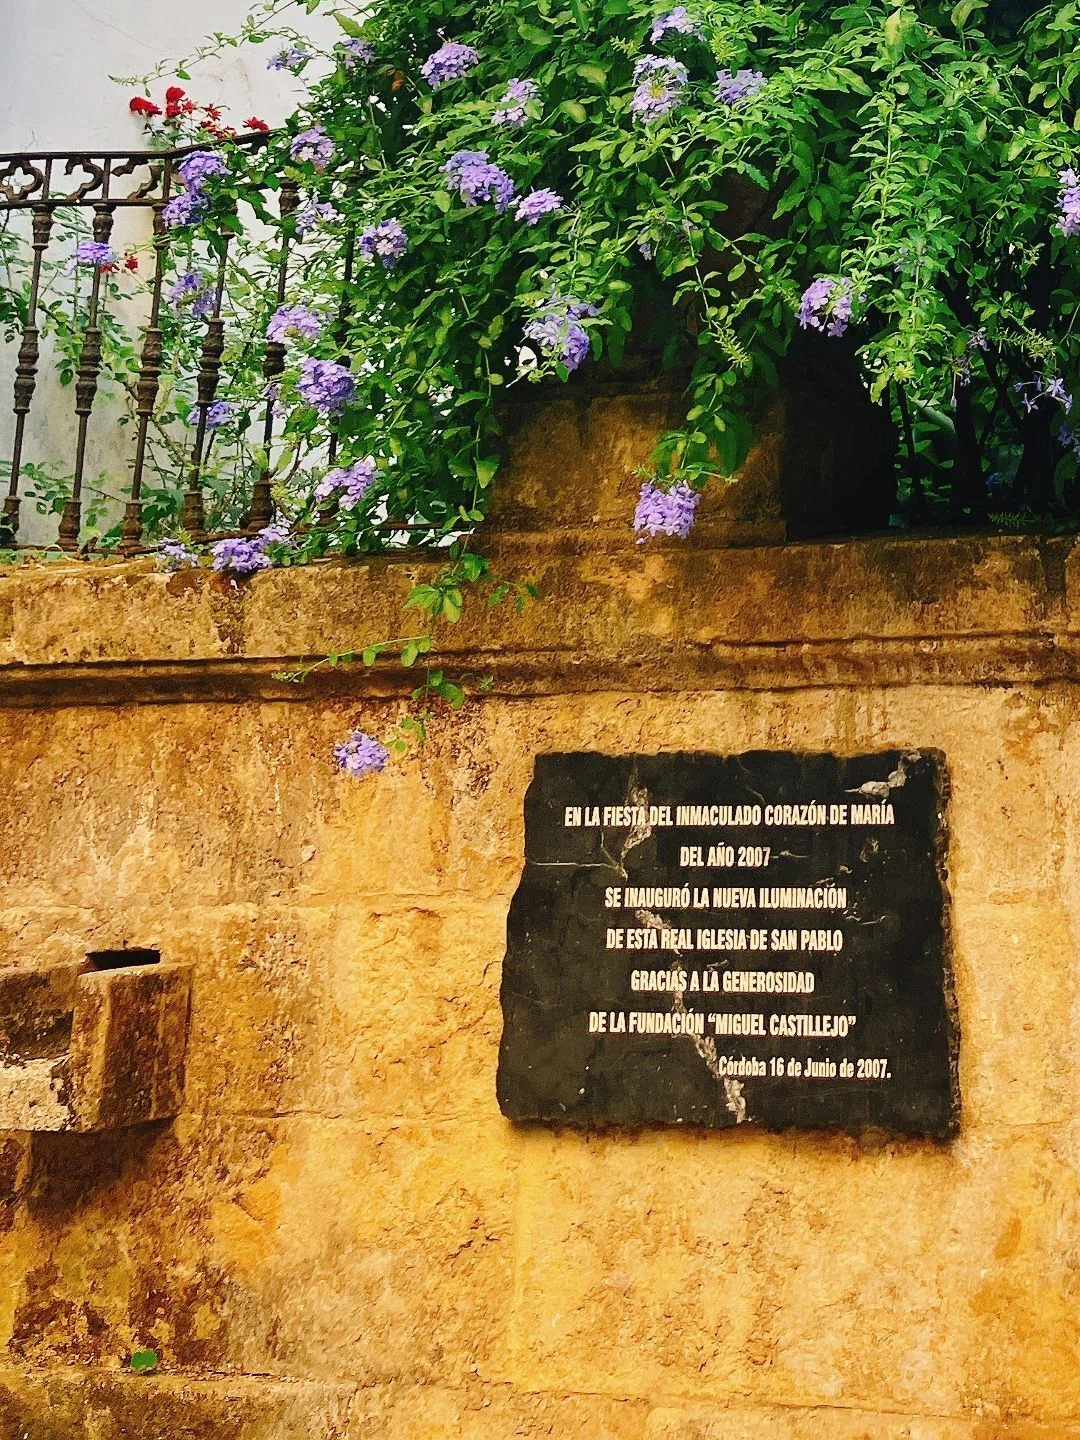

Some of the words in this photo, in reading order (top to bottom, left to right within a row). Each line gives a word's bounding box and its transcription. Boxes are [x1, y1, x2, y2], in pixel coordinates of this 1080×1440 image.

[565, 806, 582, 826] EN
[584, 806, 600, 826] LA
[603, 806, 647, 826] FIESTA
[649, 805, 674, 825] DEL
[676, 805, 761, 826] INMACULADO
[765, 800, 827, 826] CORAZÓN
[830, 805, 848, 824] DE
[851, 799, 895, 825] MARÍA
[680, 847, 706, 866] DEL
[708, 842, 735, 866] AÑO
[738, 846, 770, 866] 2007
[605, 888, 622, 908] SE
[624, 883, 689, 908] INAUGURÓ
[694, 888, 710, 908] LA
[713, 888, 756, 908] NUEVA
[759, 883, 846, 909] ILUMINACIÓN
[607, 929, 624, 949] DE
[626, 929, 658, 949] ESTA
[661, 930, 694, 949] REAL
[697, 930, 748, 950] IGLESIA
[750, 929, 768, 950] DE
[771, 930, 798, 950] SAN
[801, 930, 842, 951] PABLO
[631, 970, 686, 992] GRACIAS
[690, 972, 699, 991] A
[703, 972, 719, 992] LA
[723, 972, 814, 993] GENEROSIDAD
[589, 1012, 606, 1032] DE
[609, 1012, 626, 1033] LA
[629, 1007, 704, 1034] FUNDACIÓN
[719, 1057, 766, 1077] Córdoba
[769, 1058, 784, 1077] 16
[787, 1058, 803, 1077] de
[807, 1058, 836, 1078] Junio
[840, 1059, 854, 1078] de
[857, 1058, 891, 1079] 2007.
